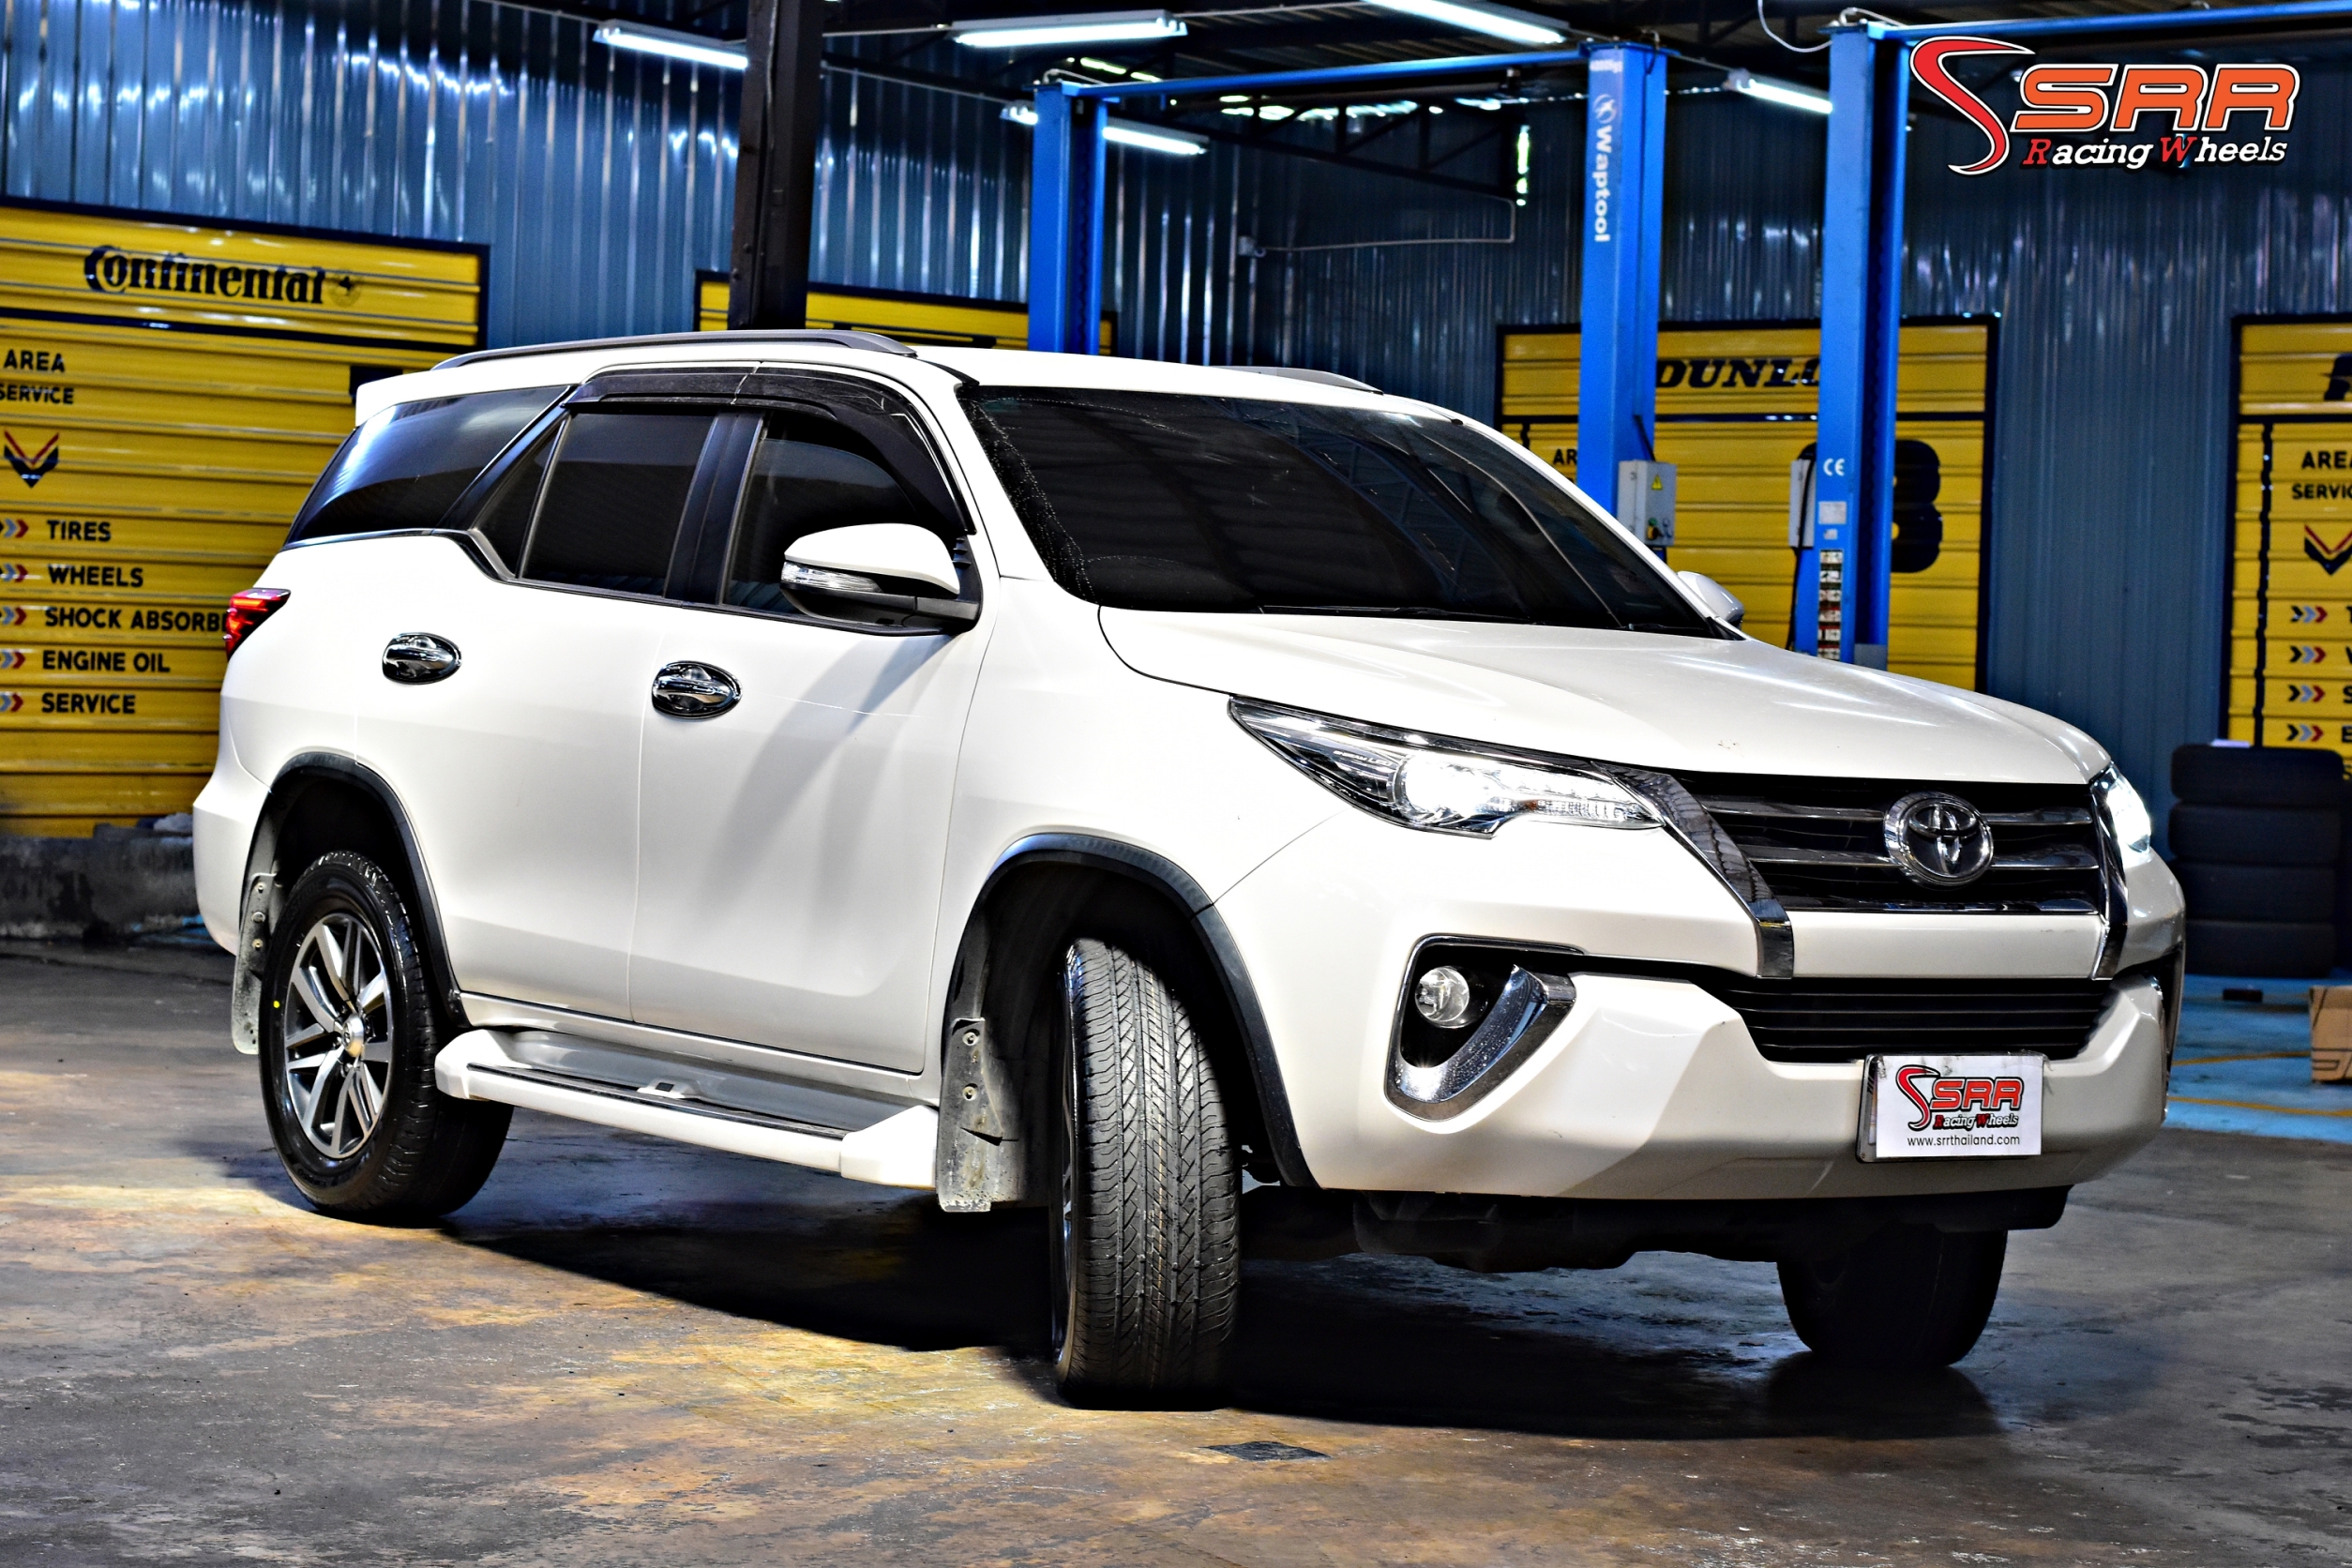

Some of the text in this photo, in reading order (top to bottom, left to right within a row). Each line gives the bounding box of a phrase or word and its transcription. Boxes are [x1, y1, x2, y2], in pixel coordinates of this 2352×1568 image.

[1592, 125, 1612, 243] Waptool
[83, 245, 325, 305] Continental
[3, 349, 65, 372] AREA
[1823, 459, 1845, 476] CE
[2300, 450, 2352, 470] ARE
[47, 520, 112, 542] TIRES
[47, 565, 143, 588] WHEELS
[45, 607, 122, 629] SHOCK
[42, 650, 171, 673] ENGINE OIL
[41, 692, 137, 715] SERVICE
[1931, 1078, 2023, 1109] SRR
[1933, 1112, 2019, 1129] Racing Wheels
[1907, 1134, 2020, 1146] www.srrthailand.com
